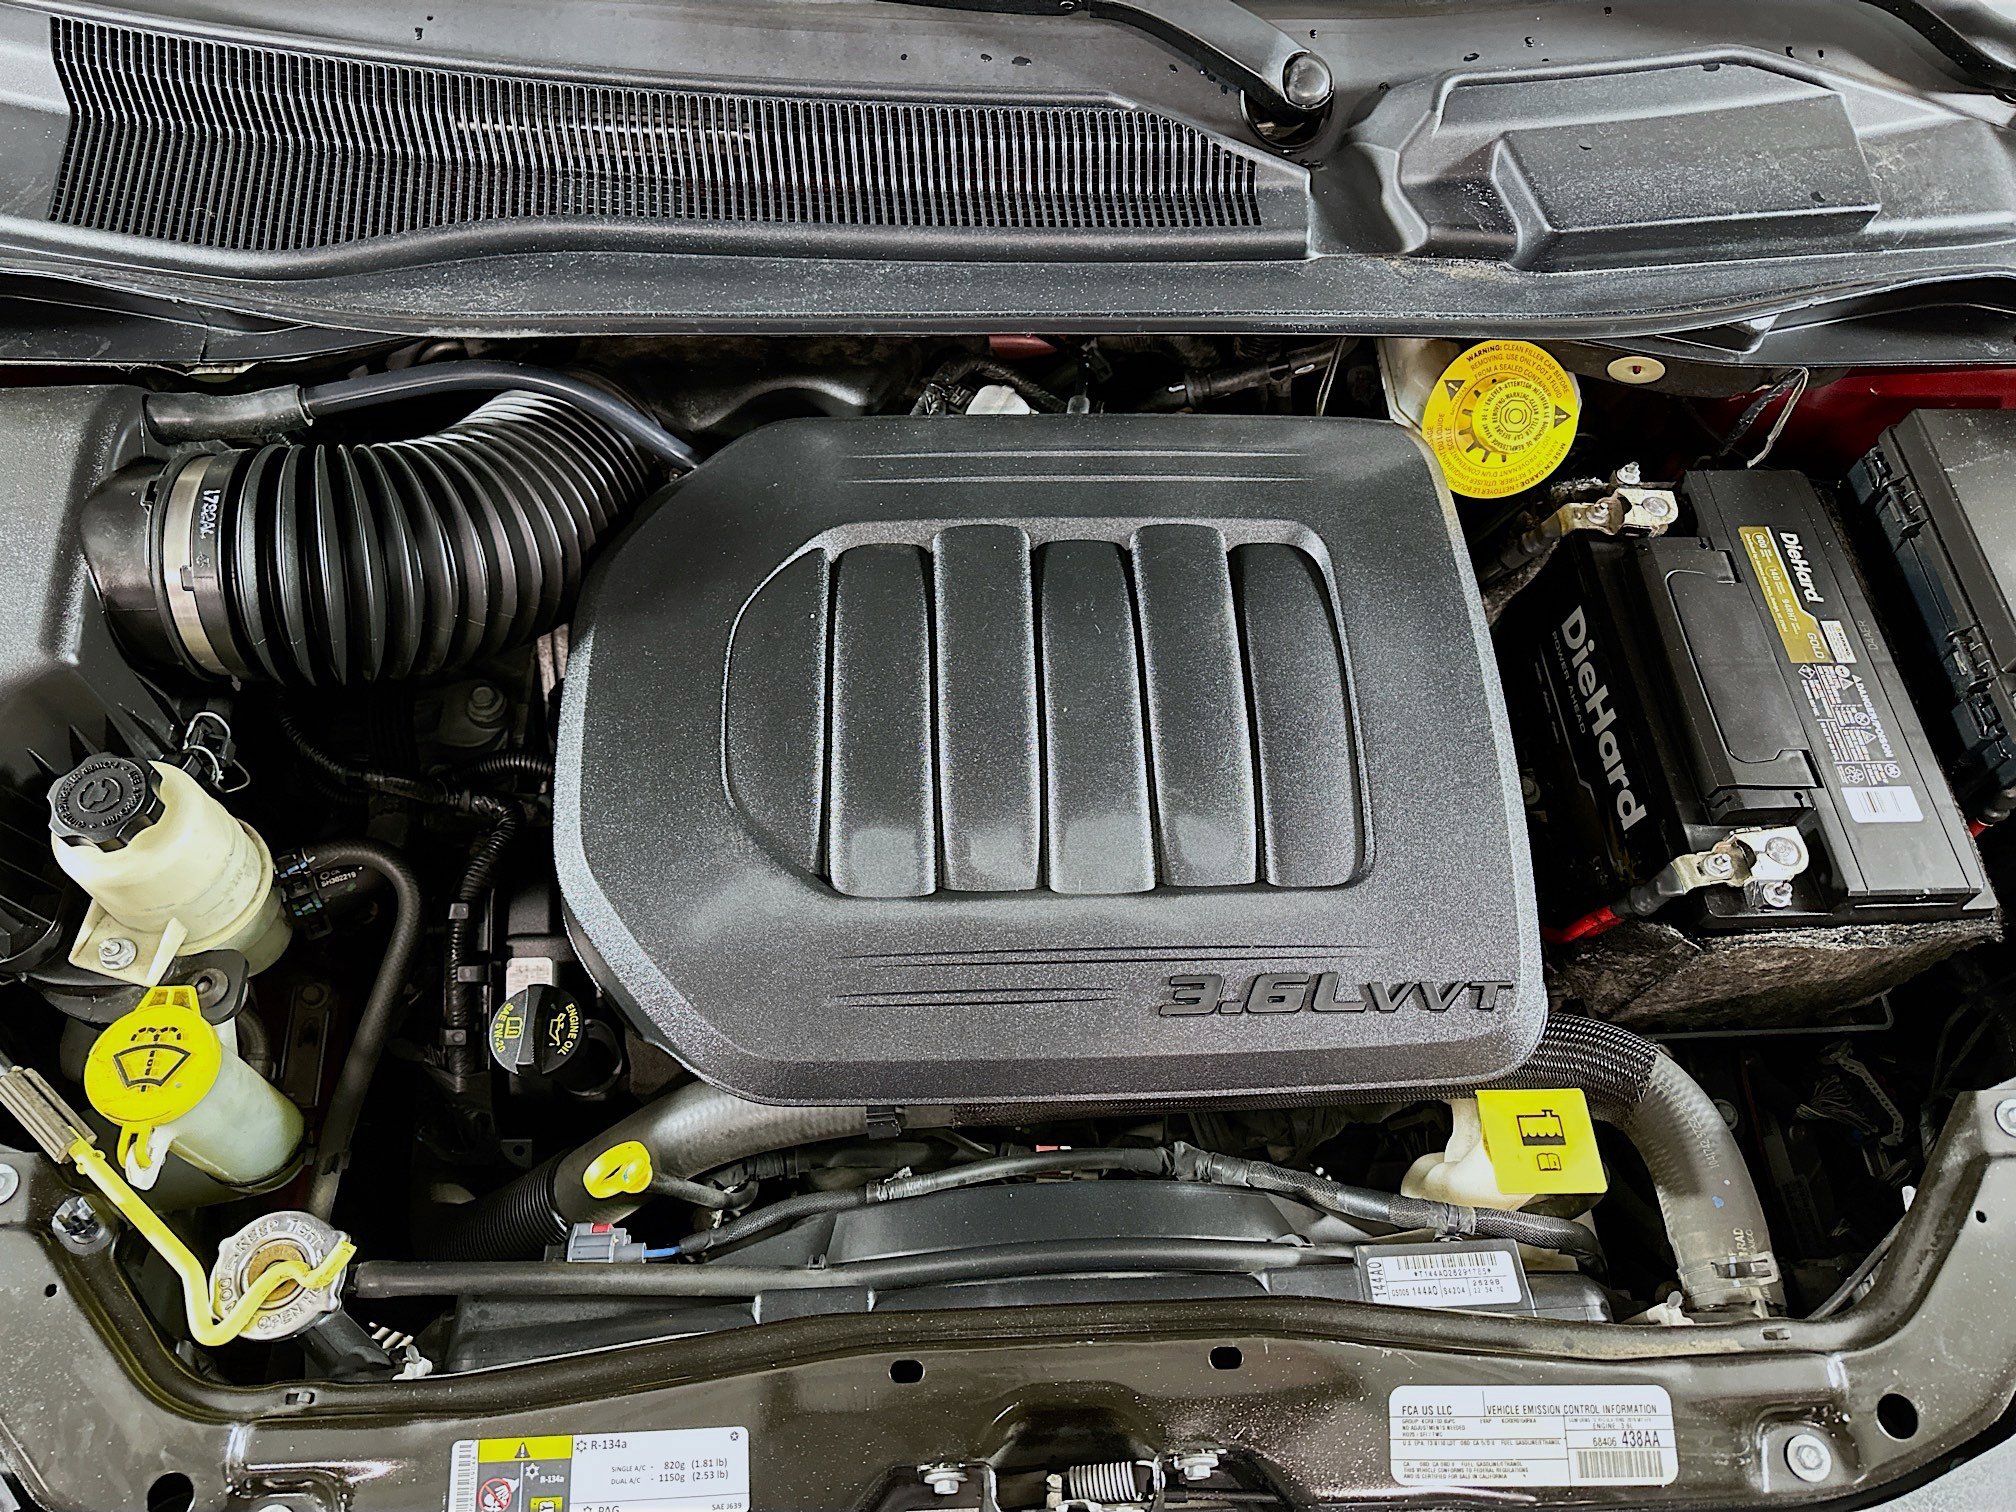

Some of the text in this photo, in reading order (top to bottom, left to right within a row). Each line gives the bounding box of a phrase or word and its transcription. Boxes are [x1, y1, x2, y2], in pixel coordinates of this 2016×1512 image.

[1466, 344, 1569, 393] WARNING: CLEAN FILLER CAP BEFORE
[1506, 353, 1518, 361] USE
[1520, 356, 1536, 368] ONLY
[1535, 365, 1548, 376] DOT
[1550, 380, 1562, 399] FLUID
[1475, 367, 1492, 380] FROM
[1500, 364, 1523, 373] SEALED
[1524, 369, 1552, 397] CONTAINER
[1553, 443, 1566, 460] MISE
[1545, 461, 1554, 471] EN
[1469, 478, 1497, 487] UTILISER
[1481, 486, 1515, 495] NETTOYER
[1769, 568, 1780, 581] 140
[1780, 532, 1825, 603] DieHard
[1807, 632, 1825, 659] GOLD
[1551, 630, 1586, 733] POWER AHEAD
[1561, 605, 1647, 831] DieHard
[498, 1002, 514, 1021] SAE
[557, 1003, 579, 1056] ENGINE OIL
[258, 1304, 304, 1329] OPEN
[1402, 1404, 1657, 1415] FCA US LLC VEHICLE EMISSION CONTROL INFORMATION
[591, 1439, 627, 1450] R-134a
[1592, 1430, 1660, 1447] 68406 438AA
[664, 1461, 685, 1471] 820g
[691, 1458, 713, 1469] (1.81
[716, 1458, 728, 1468] lb)
[540, 1475, 565, 1484] R-134a
[659, 1473, 685, 1483] 1150g
[692, 1471, 715, 1481] (2.53
[716, 1470, 729, 1480] lb)
[726, 1502, 742, 1510] J639
